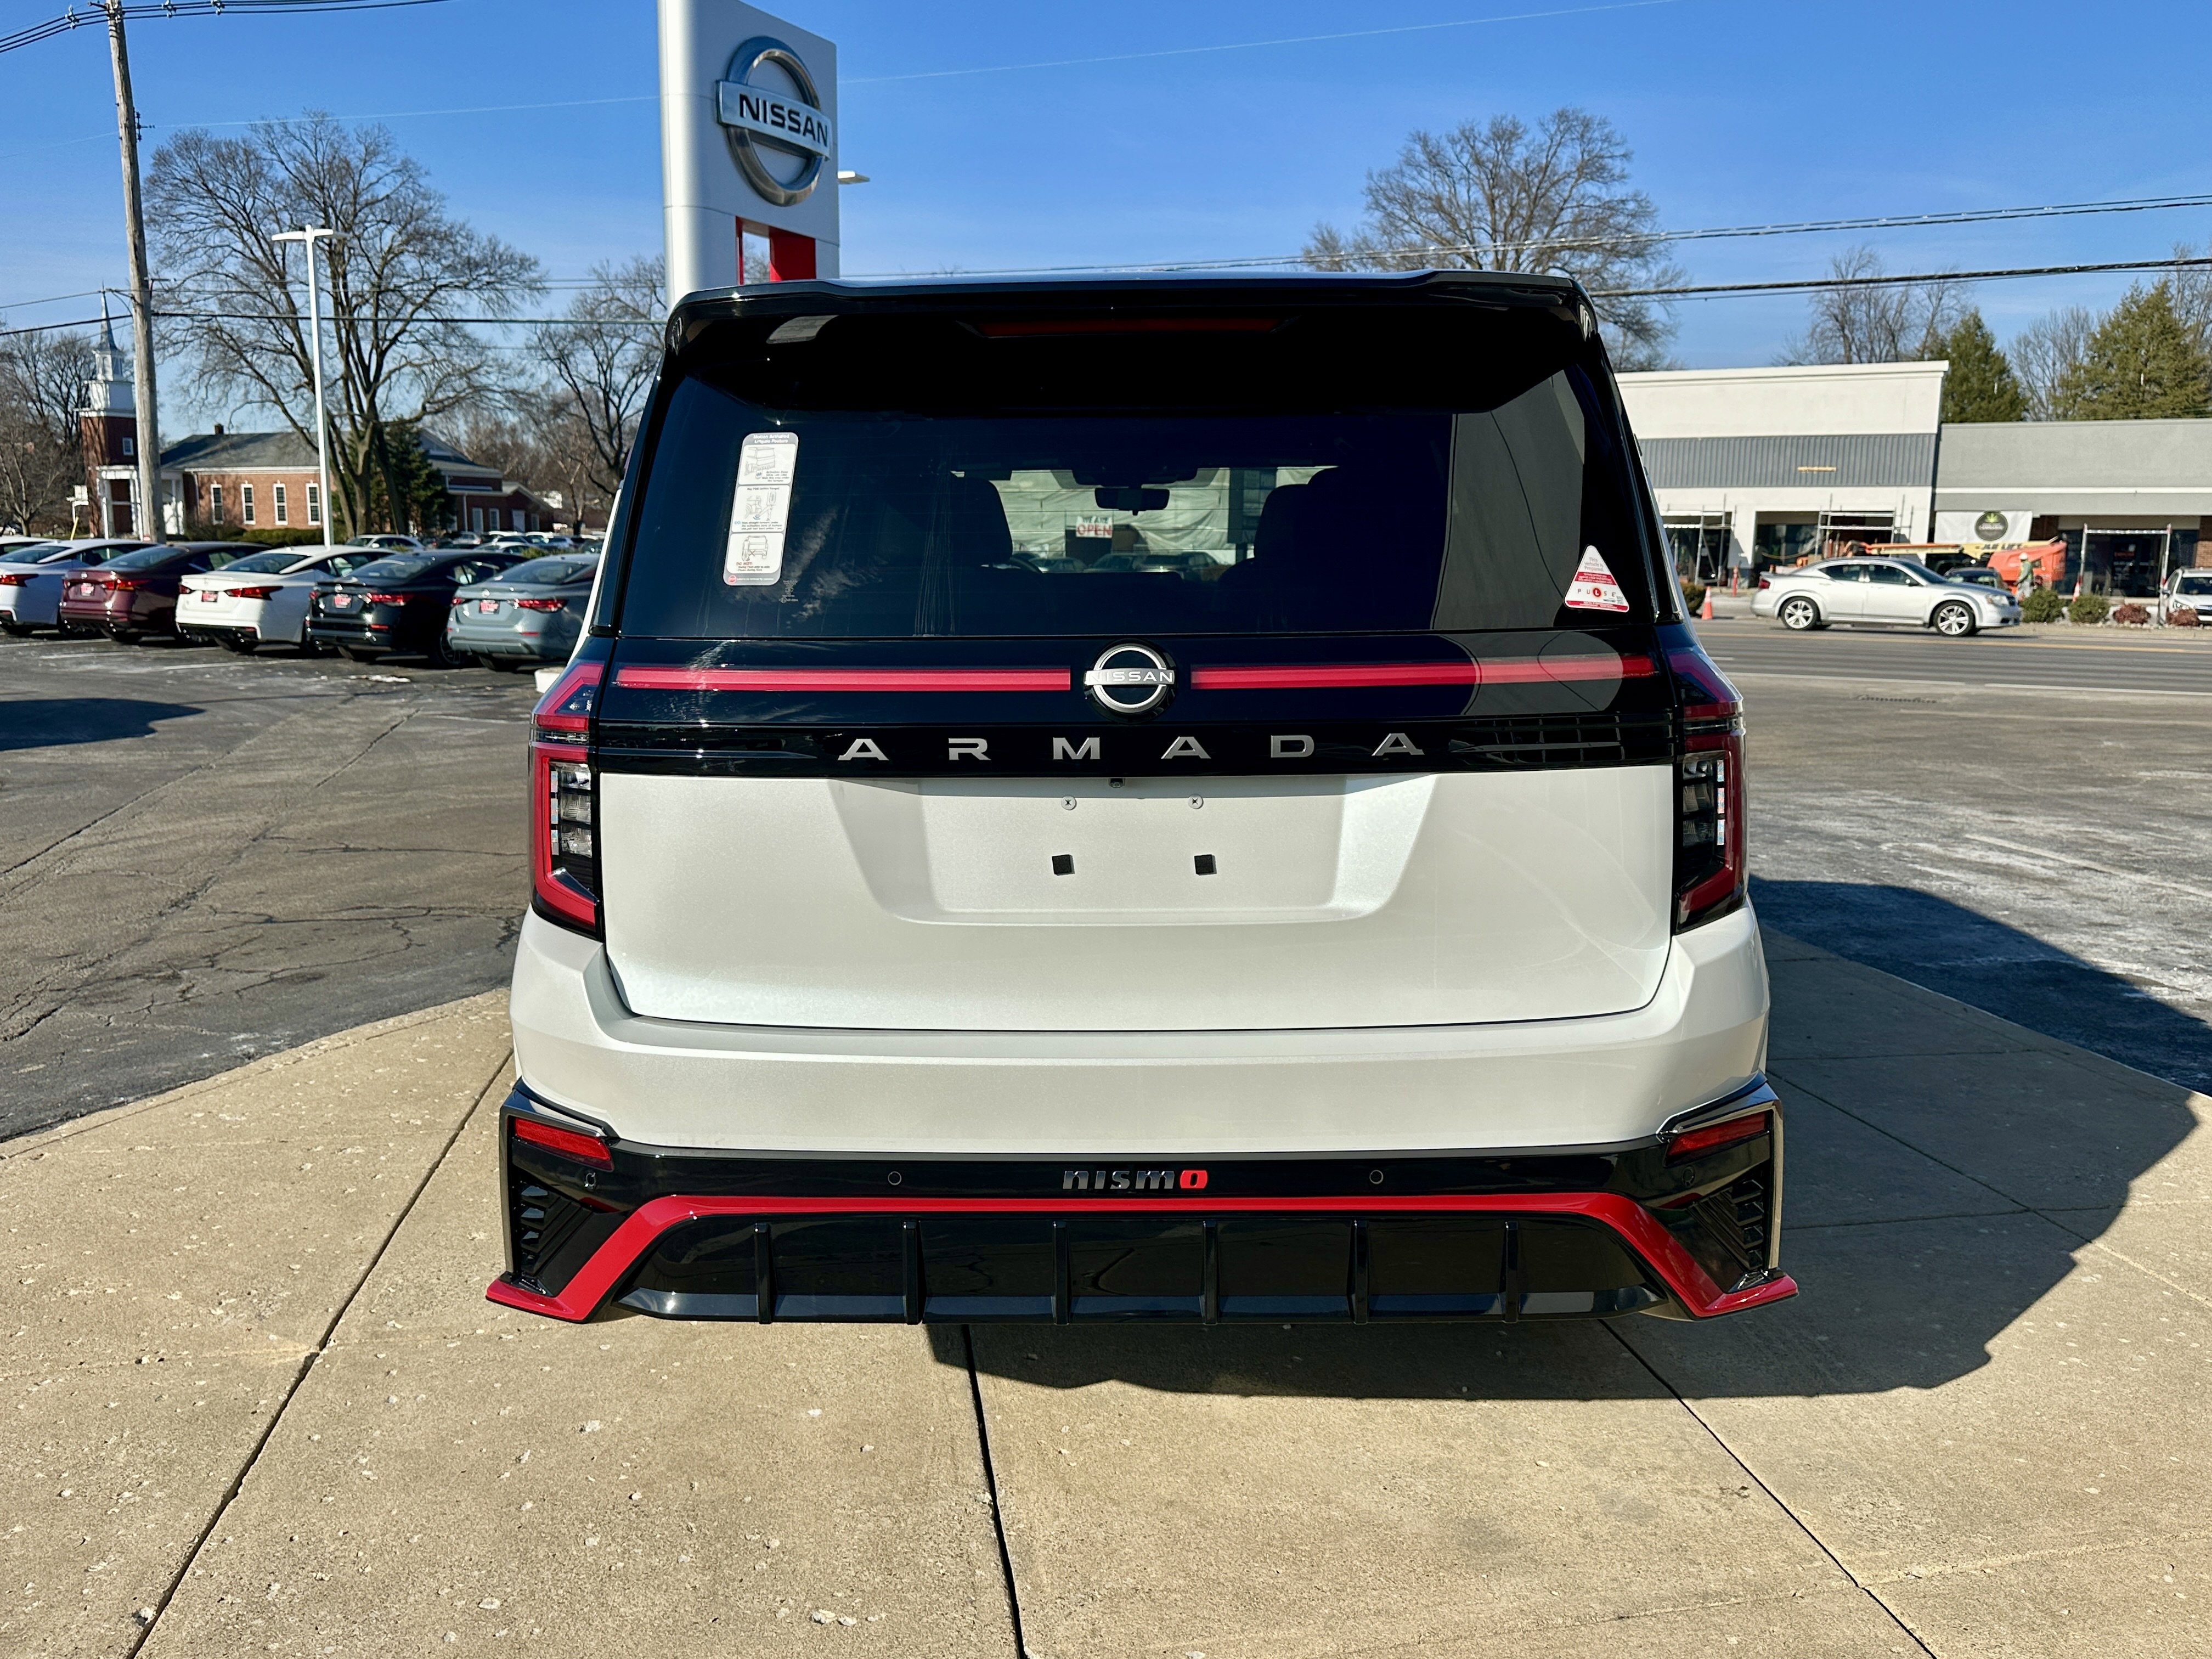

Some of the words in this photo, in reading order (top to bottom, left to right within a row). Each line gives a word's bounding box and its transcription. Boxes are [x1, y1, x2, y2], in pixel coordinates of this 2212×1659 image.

[739, 93, 828, 147] NISSAN
[1077, 523, 1112, 536] OPEN
[1577, 588, 1616, 597] PULSE
[1089, 670, 1173, 682] NISSAN
[837, 732, 1425, 761] ARMADA
